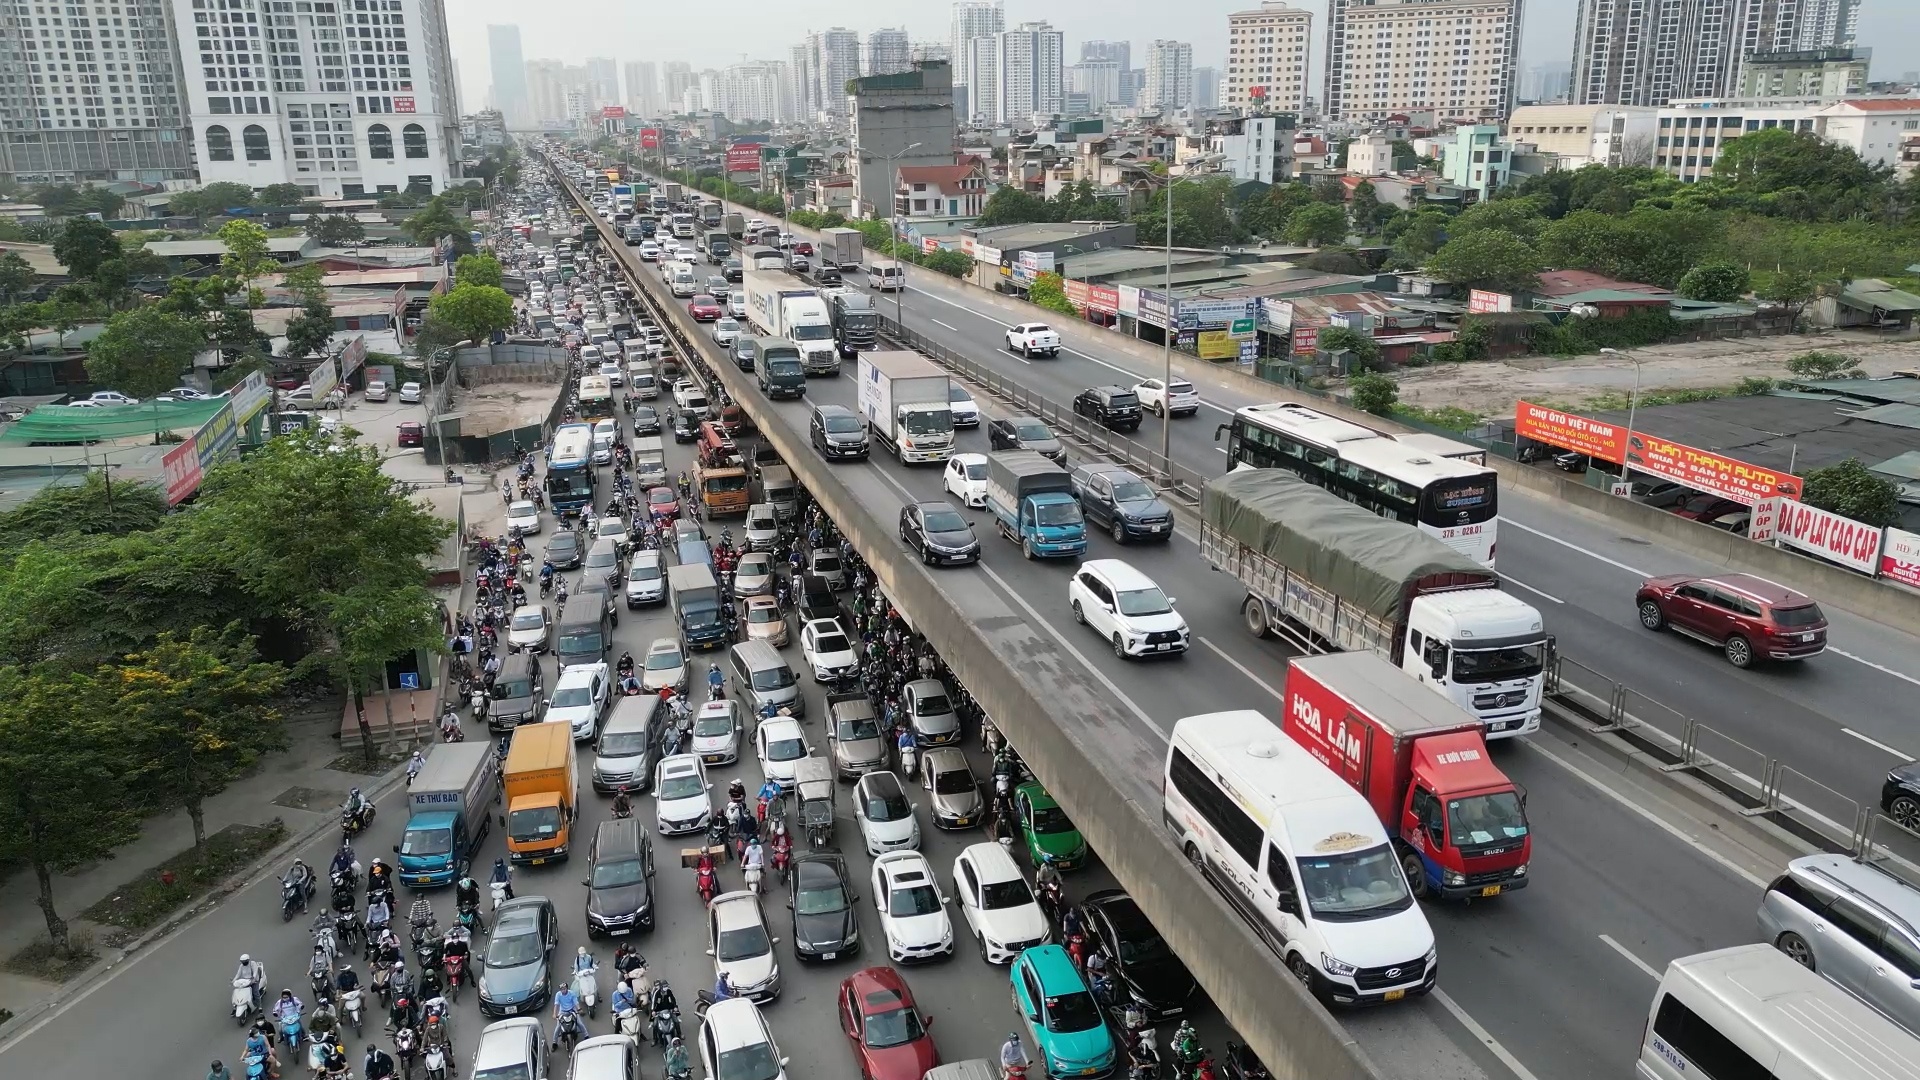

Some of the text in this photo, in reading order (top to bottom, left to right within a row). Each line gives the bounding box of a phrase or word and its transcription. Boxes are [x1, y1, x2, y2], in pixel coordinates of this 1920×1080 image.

[1529, 407, 1613, 437] CHỢ ÔTÔ VIỆT NAM
[1526, 419, 1538, 427] MUA
[1551, 425, 1565, 435] TRAO
[1566, 429, 1576, 438] ĐỔI
[1603, 440, 1615, 449] MỚI
[1648, 451, 1674, 465] MUA
[1677, 461, 1686, 469] &
[1690, 464, 1716, 478] BÁN
[1719, 472, 1729, 481] Ô
[1732, 476, 1748, 487] TÔ
[1735, 465, 1776, 486] AUTO
[1653, 462, 1666, 471] UY
[1668, 466, 1685, 477] TÍN
[1695, 475, 1722, 488] CHẤT
[1724, 484, 1761, 500] LƯỢNG
[1615, 485, 1627, 495] ĐÁ
[1758, 501, 1773, 513] ĐÁ
[1756, 514, 1771, 526] ỐP
[1443, 529, 1455, 539] 37B
[1462, 525, 1482, 536] 028.01
[1751, 529, 1771, 540] LÁT
[1830, 519, 1854, 556] CAO
[1293, 693, 1321, 734] HOA
[1327, 718, 1360, 764] LÂM
[1436, 754, 1447, 764] XE
[416, 795, 425, 804] XE
[427, 793, 441, 803] THƯ
[1484, 848, 1504, 856] ISUZU
[1220, 860, 1255, 900] SOLATI
